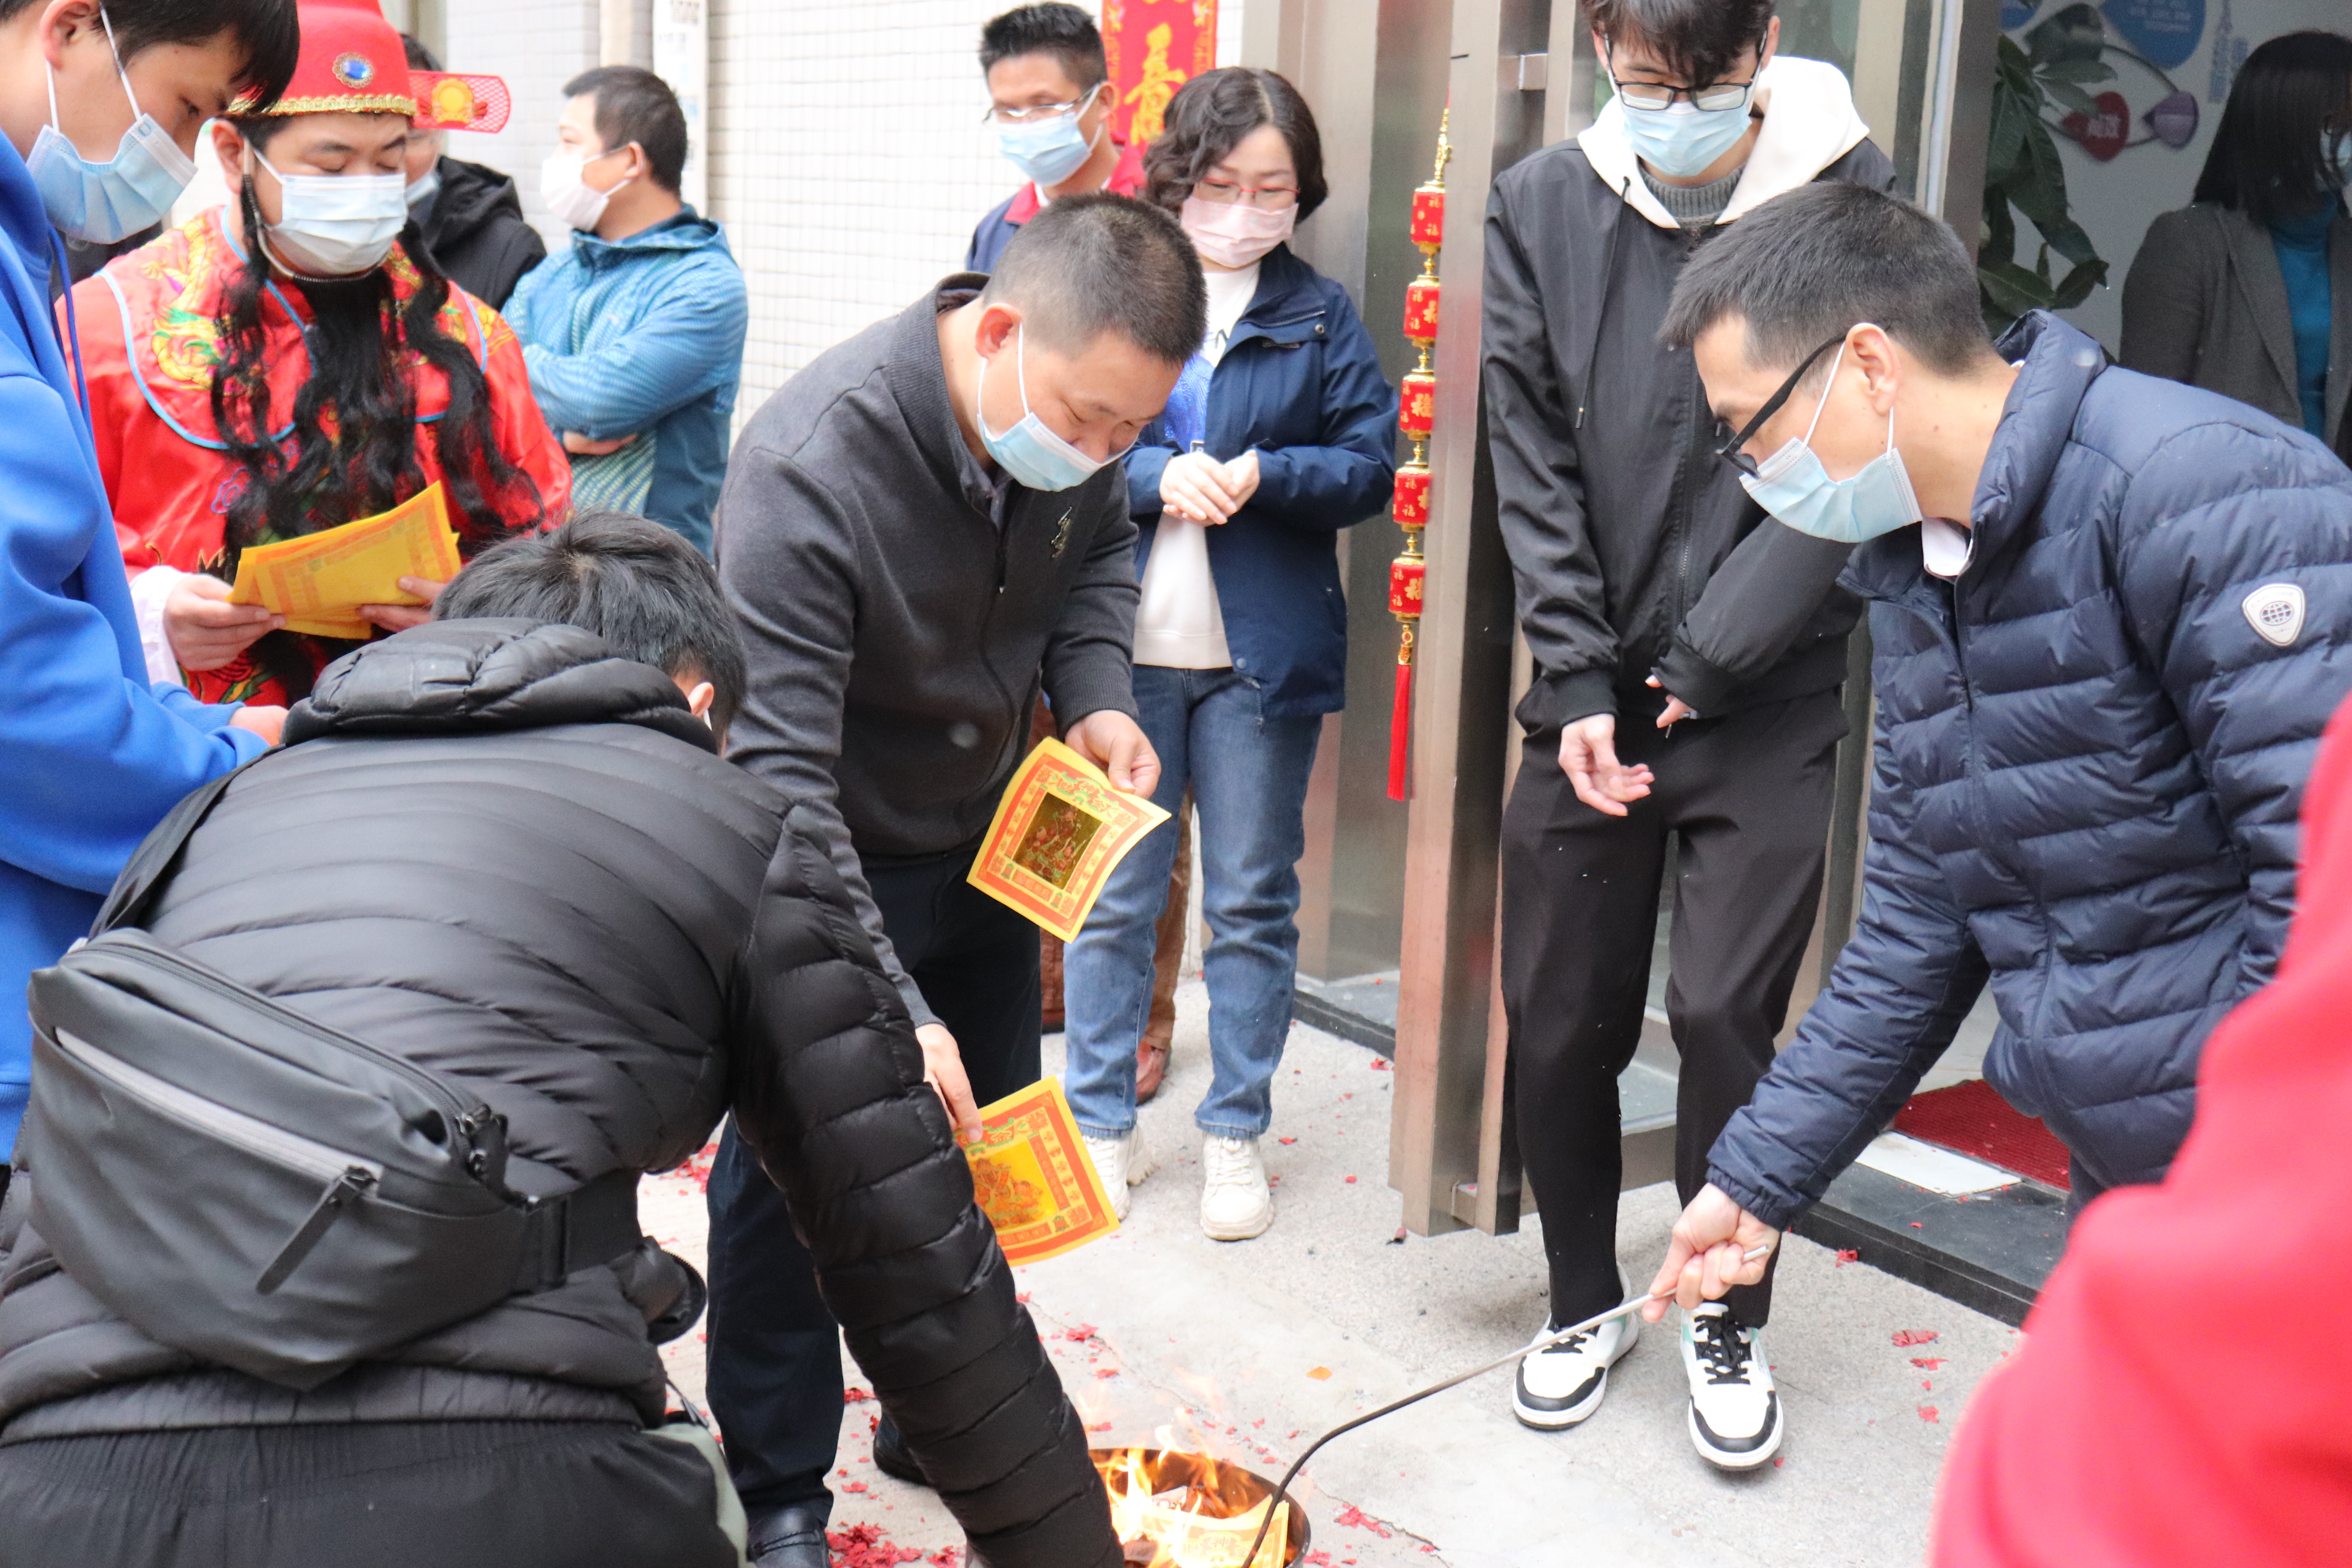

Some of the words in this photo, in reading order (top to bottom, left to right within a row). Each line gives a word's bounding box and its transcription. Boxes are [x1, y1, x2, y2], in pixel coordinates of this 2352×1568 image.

[2251, 592, 2294, 608] EXPLORE
[1059, 780, 1107, 811] 財神金
